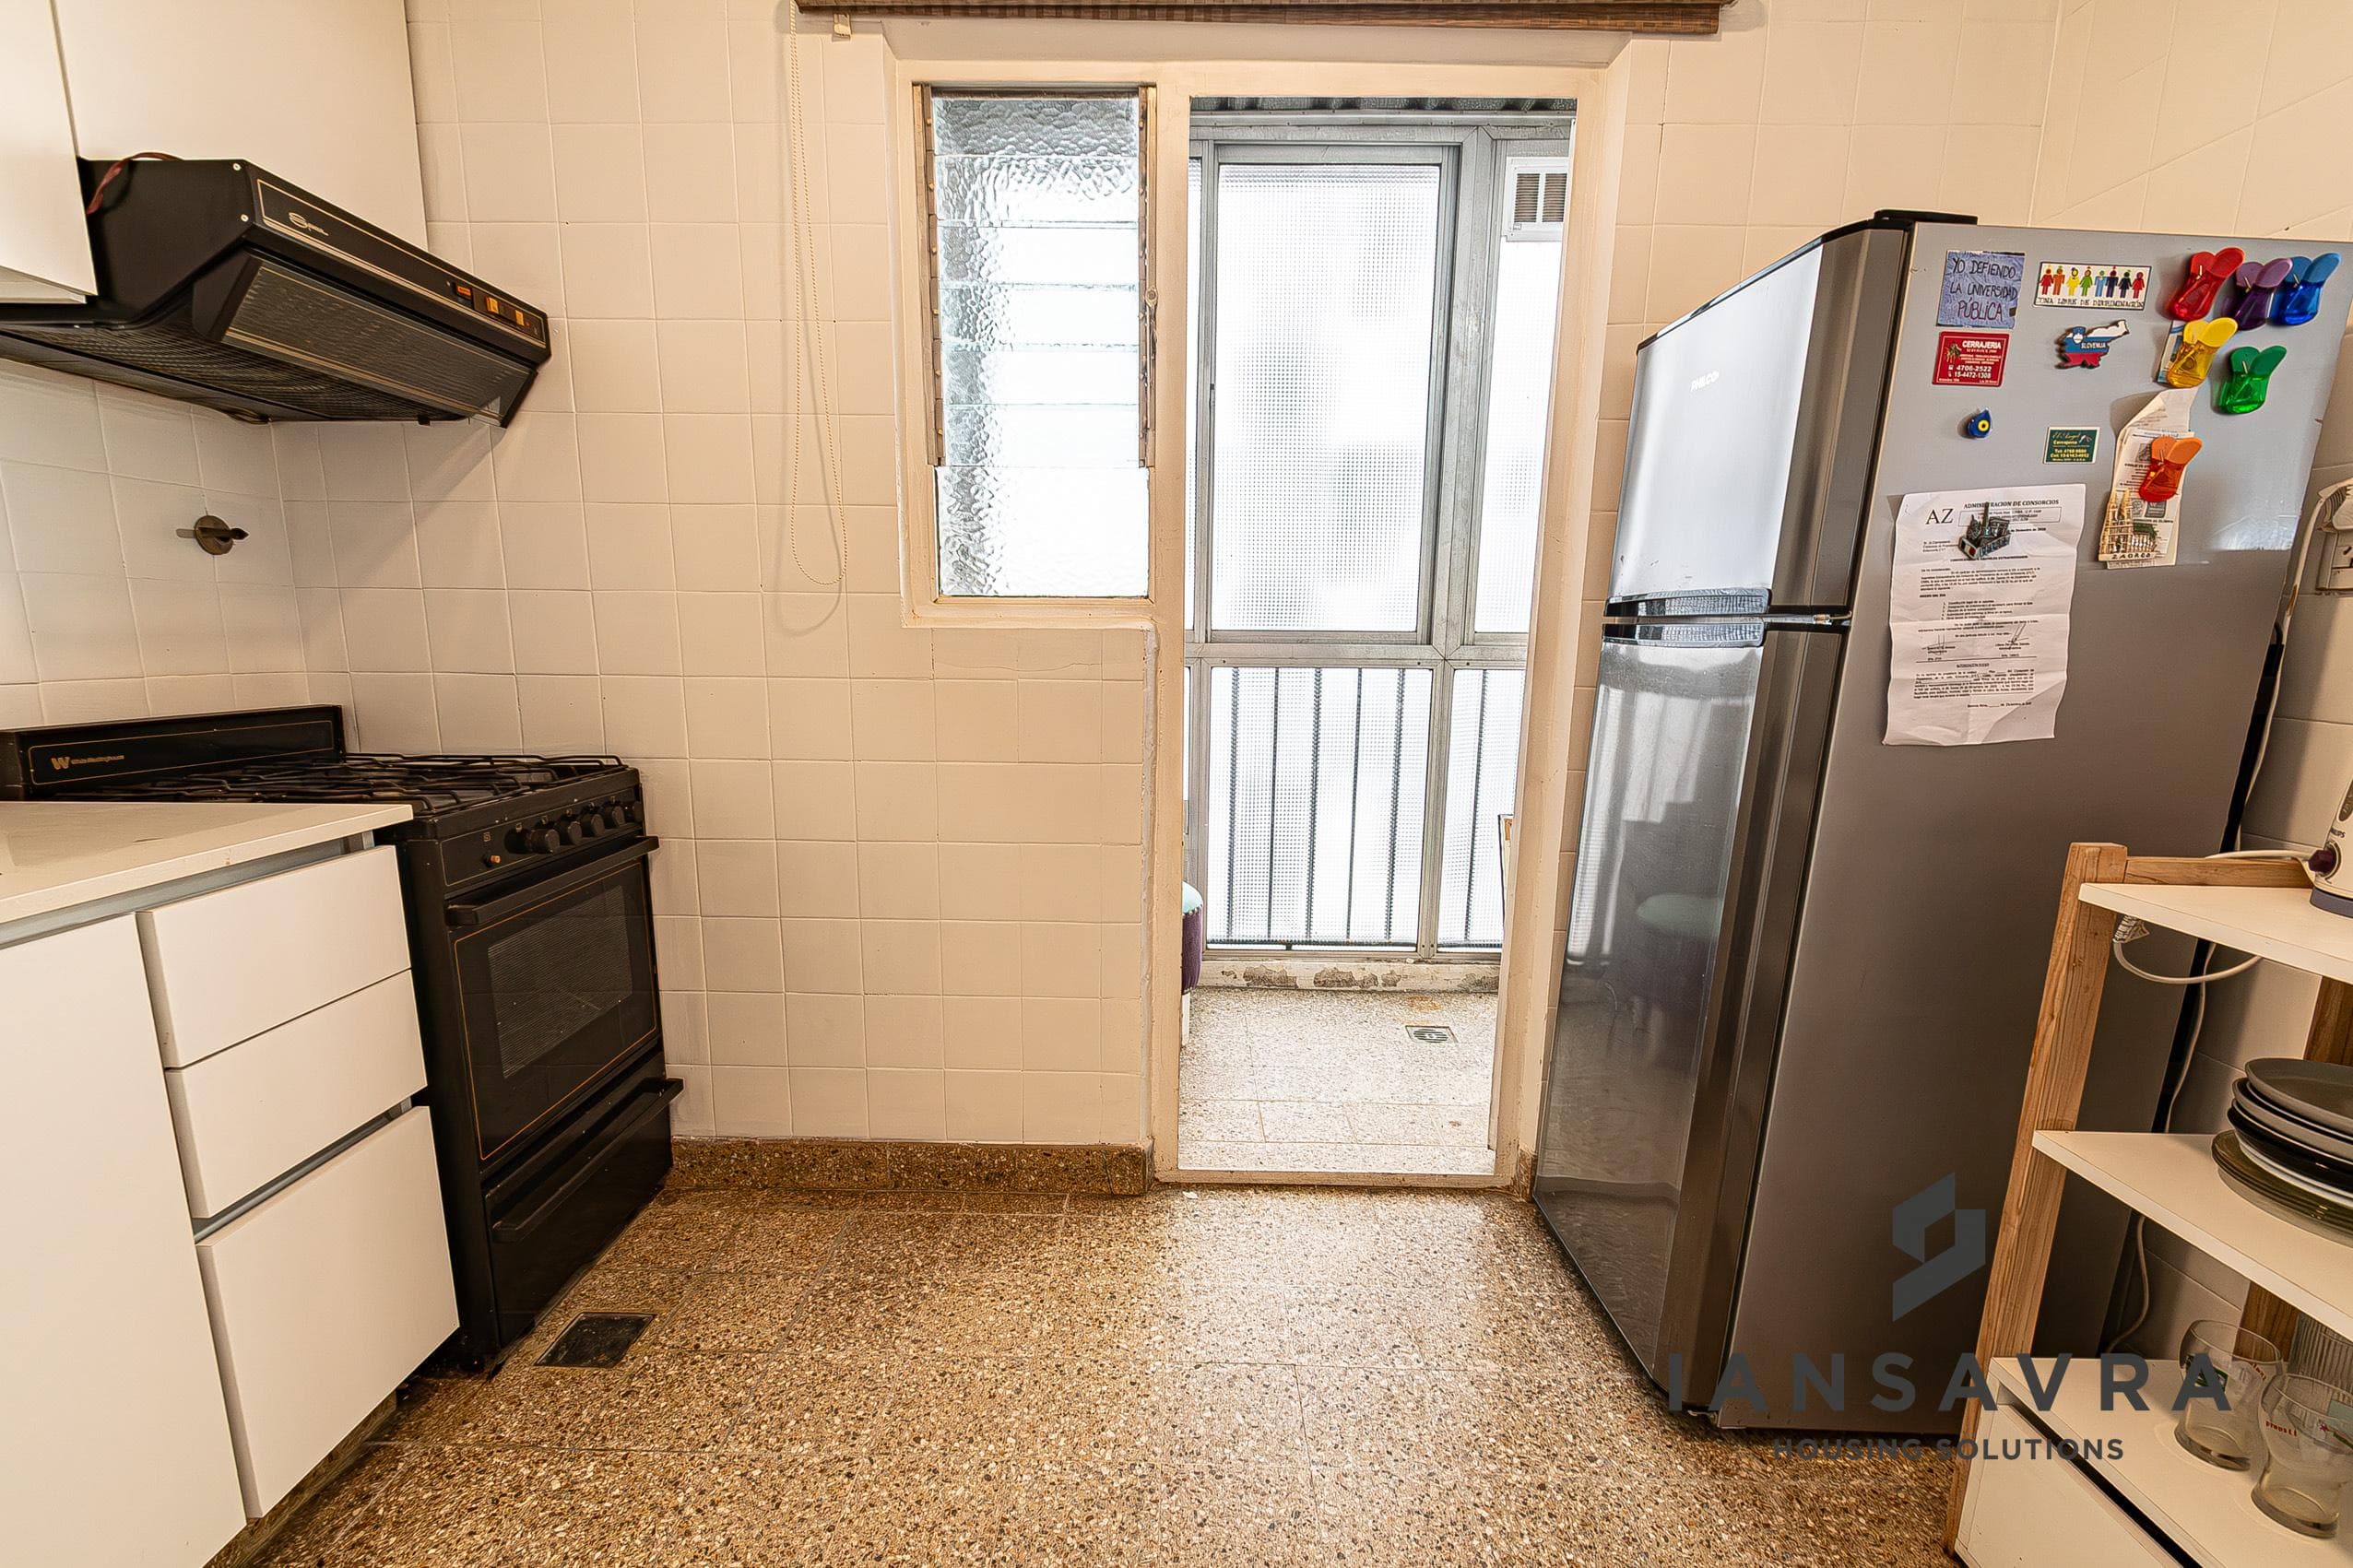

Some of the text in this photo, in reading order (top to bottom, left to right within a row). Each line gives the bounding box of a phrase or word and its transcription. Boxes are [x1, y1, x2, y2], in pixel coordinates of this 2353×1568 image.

[1952, 257, 2016, 279] YO DEFIENDO
[1949, 281, 2018, 301] LA UNIVERSIDAD
[1690, 371, 1720, 392] PHILCO
[1964, 501, 2012, 510] ADMINIRACION
[1925, 508, 1954, 525] AZ
